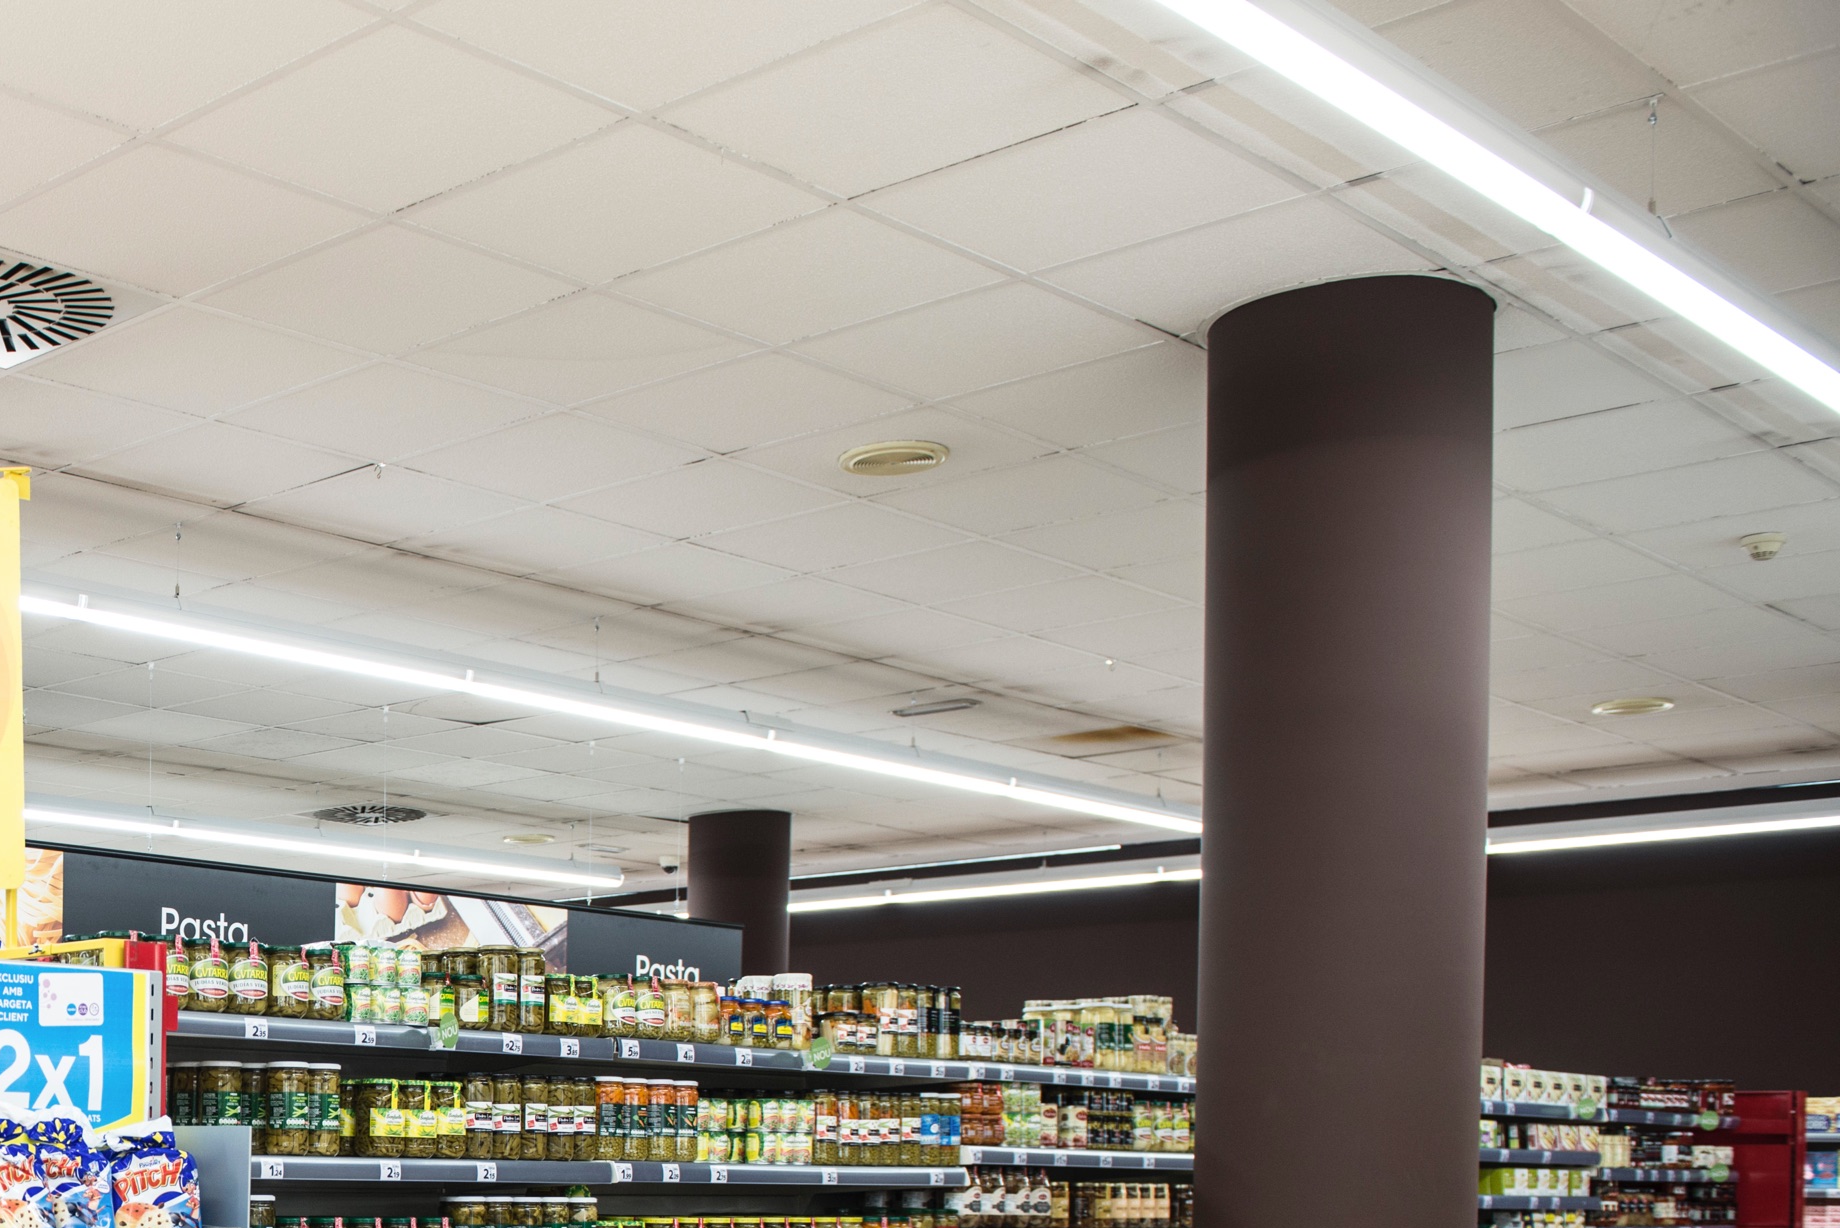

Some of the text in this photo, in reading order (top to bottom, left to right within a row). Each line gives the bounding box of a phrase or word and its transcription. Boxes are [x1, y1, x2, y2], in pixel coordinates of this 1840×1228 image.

[161, 907, 249, 945] Pasta
[636, 955, 700, 982] Pasta
[2, 986, 23, 996] AMB
[441, 1024, 458, 1040] NOU
[813, 1048, 831, 1062] NOU
